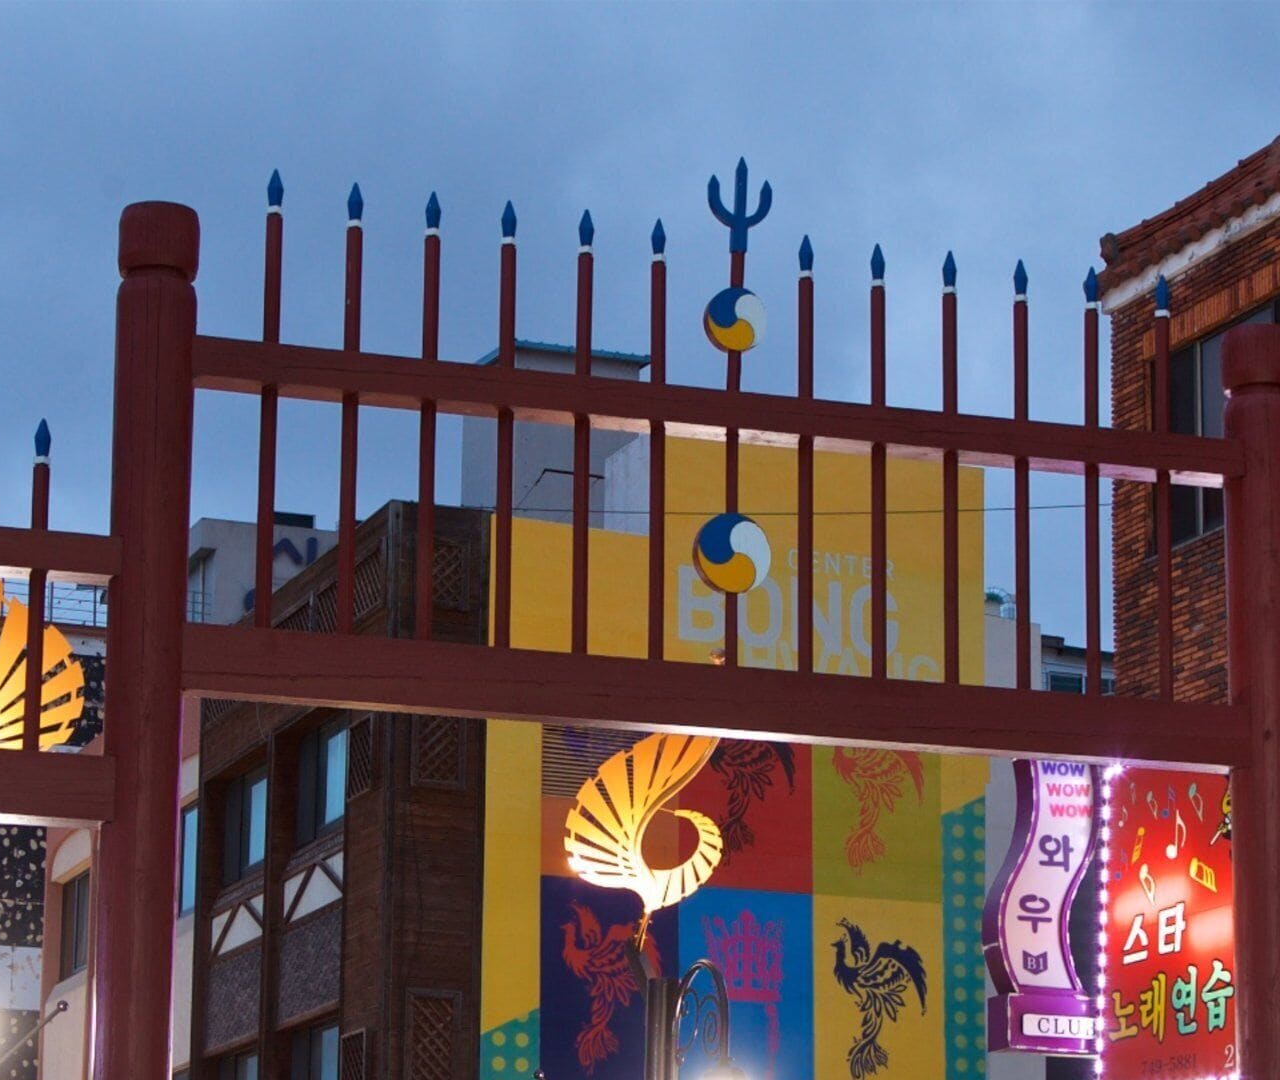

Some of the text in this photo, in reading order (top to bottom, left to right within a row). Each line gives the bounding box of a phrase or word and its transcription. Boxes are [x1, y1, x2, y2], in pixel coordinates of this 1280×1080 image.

[1041, 762, 1085, 777] WOW
[1046, 782, 1091, 797] WOW
[1049, 804, 1093, 818] WOW
[1016, 833, 1075, 934] 와우
[1122, 901, 1187, 965] 스타
[1026, 957, 1045, 971] B1
